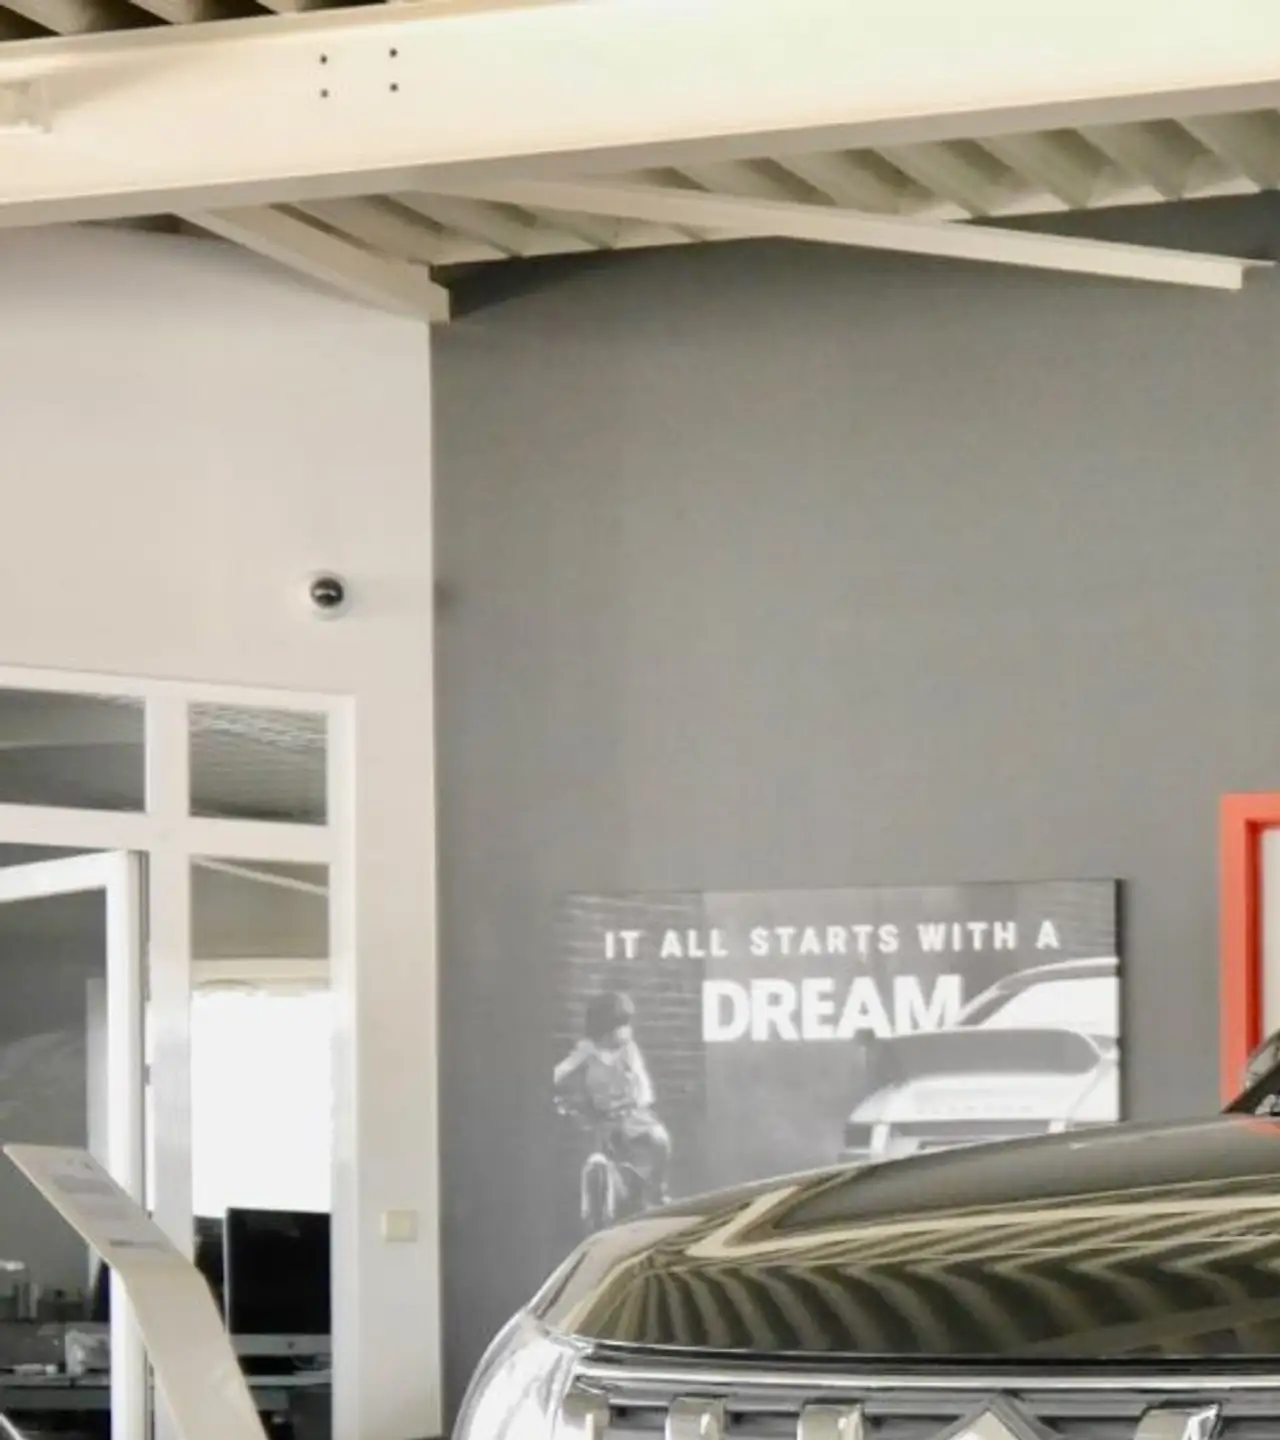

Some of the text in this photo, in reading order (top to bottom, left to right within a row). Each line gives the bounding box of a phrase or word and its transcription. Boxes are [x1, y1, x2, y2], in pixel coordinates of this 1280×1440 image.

[605, 919, 1061, 959] IT ALL STARTS WITH A
[702, 974, 964, 1043] DREAM
